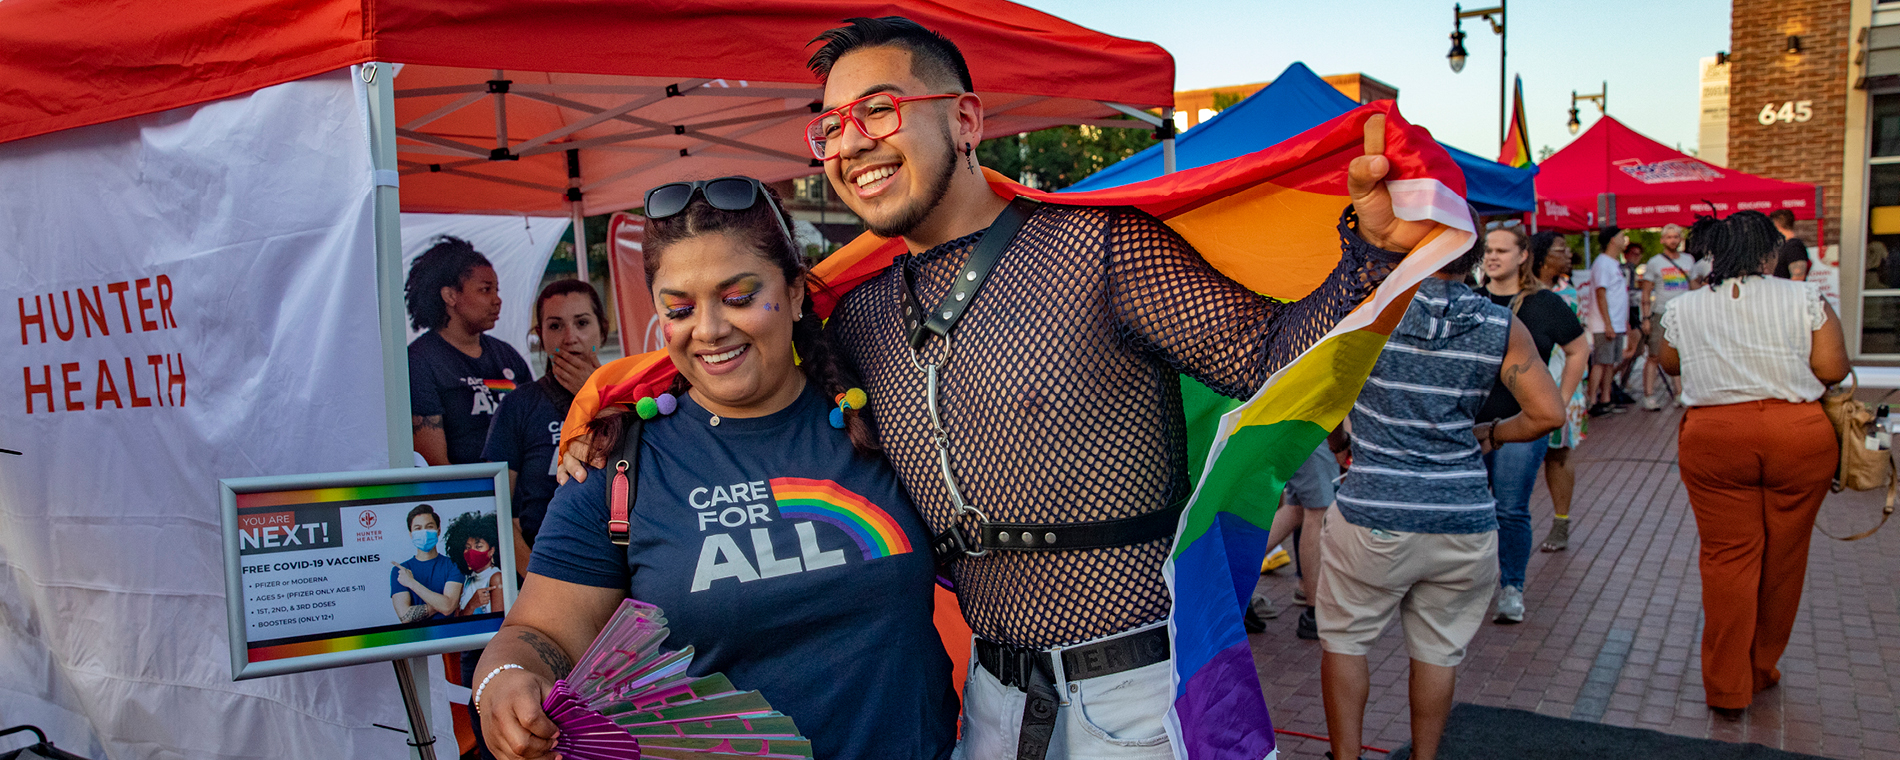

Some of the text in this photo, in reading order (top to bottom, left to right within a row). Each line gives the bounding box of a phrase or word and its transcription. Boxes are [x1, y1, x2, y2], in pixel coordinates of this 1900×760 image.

[1758, 100, 1813, 126] 645
[18, 274, 177, 345] HUNTER
[24, 353, 186, 414] HEALTH
[689, 480, 769, 510] CARE
[243, 514, 290, 526] YOU ARE
[698, 503, 772, 532] FOR
[238, 522, 328, 550] NEXT!
[242, 554, 380, 574] FREE COVID-19 VACCINES
[690, 521, 846, 593] ALL
[255, 580, 280, 589] PFIZER
[291, 576, 328, 585] MODERNA
[256, 594, 275, 602] AGES
[287, 590, 314, 600] (PFIZER
[316, 588, 334, 596] ONLY
[312, 601, 336, 609] DOSES
[258, 618, 297, 628] BOOSTERS
[298, 615, 320, 624] (ONLY
